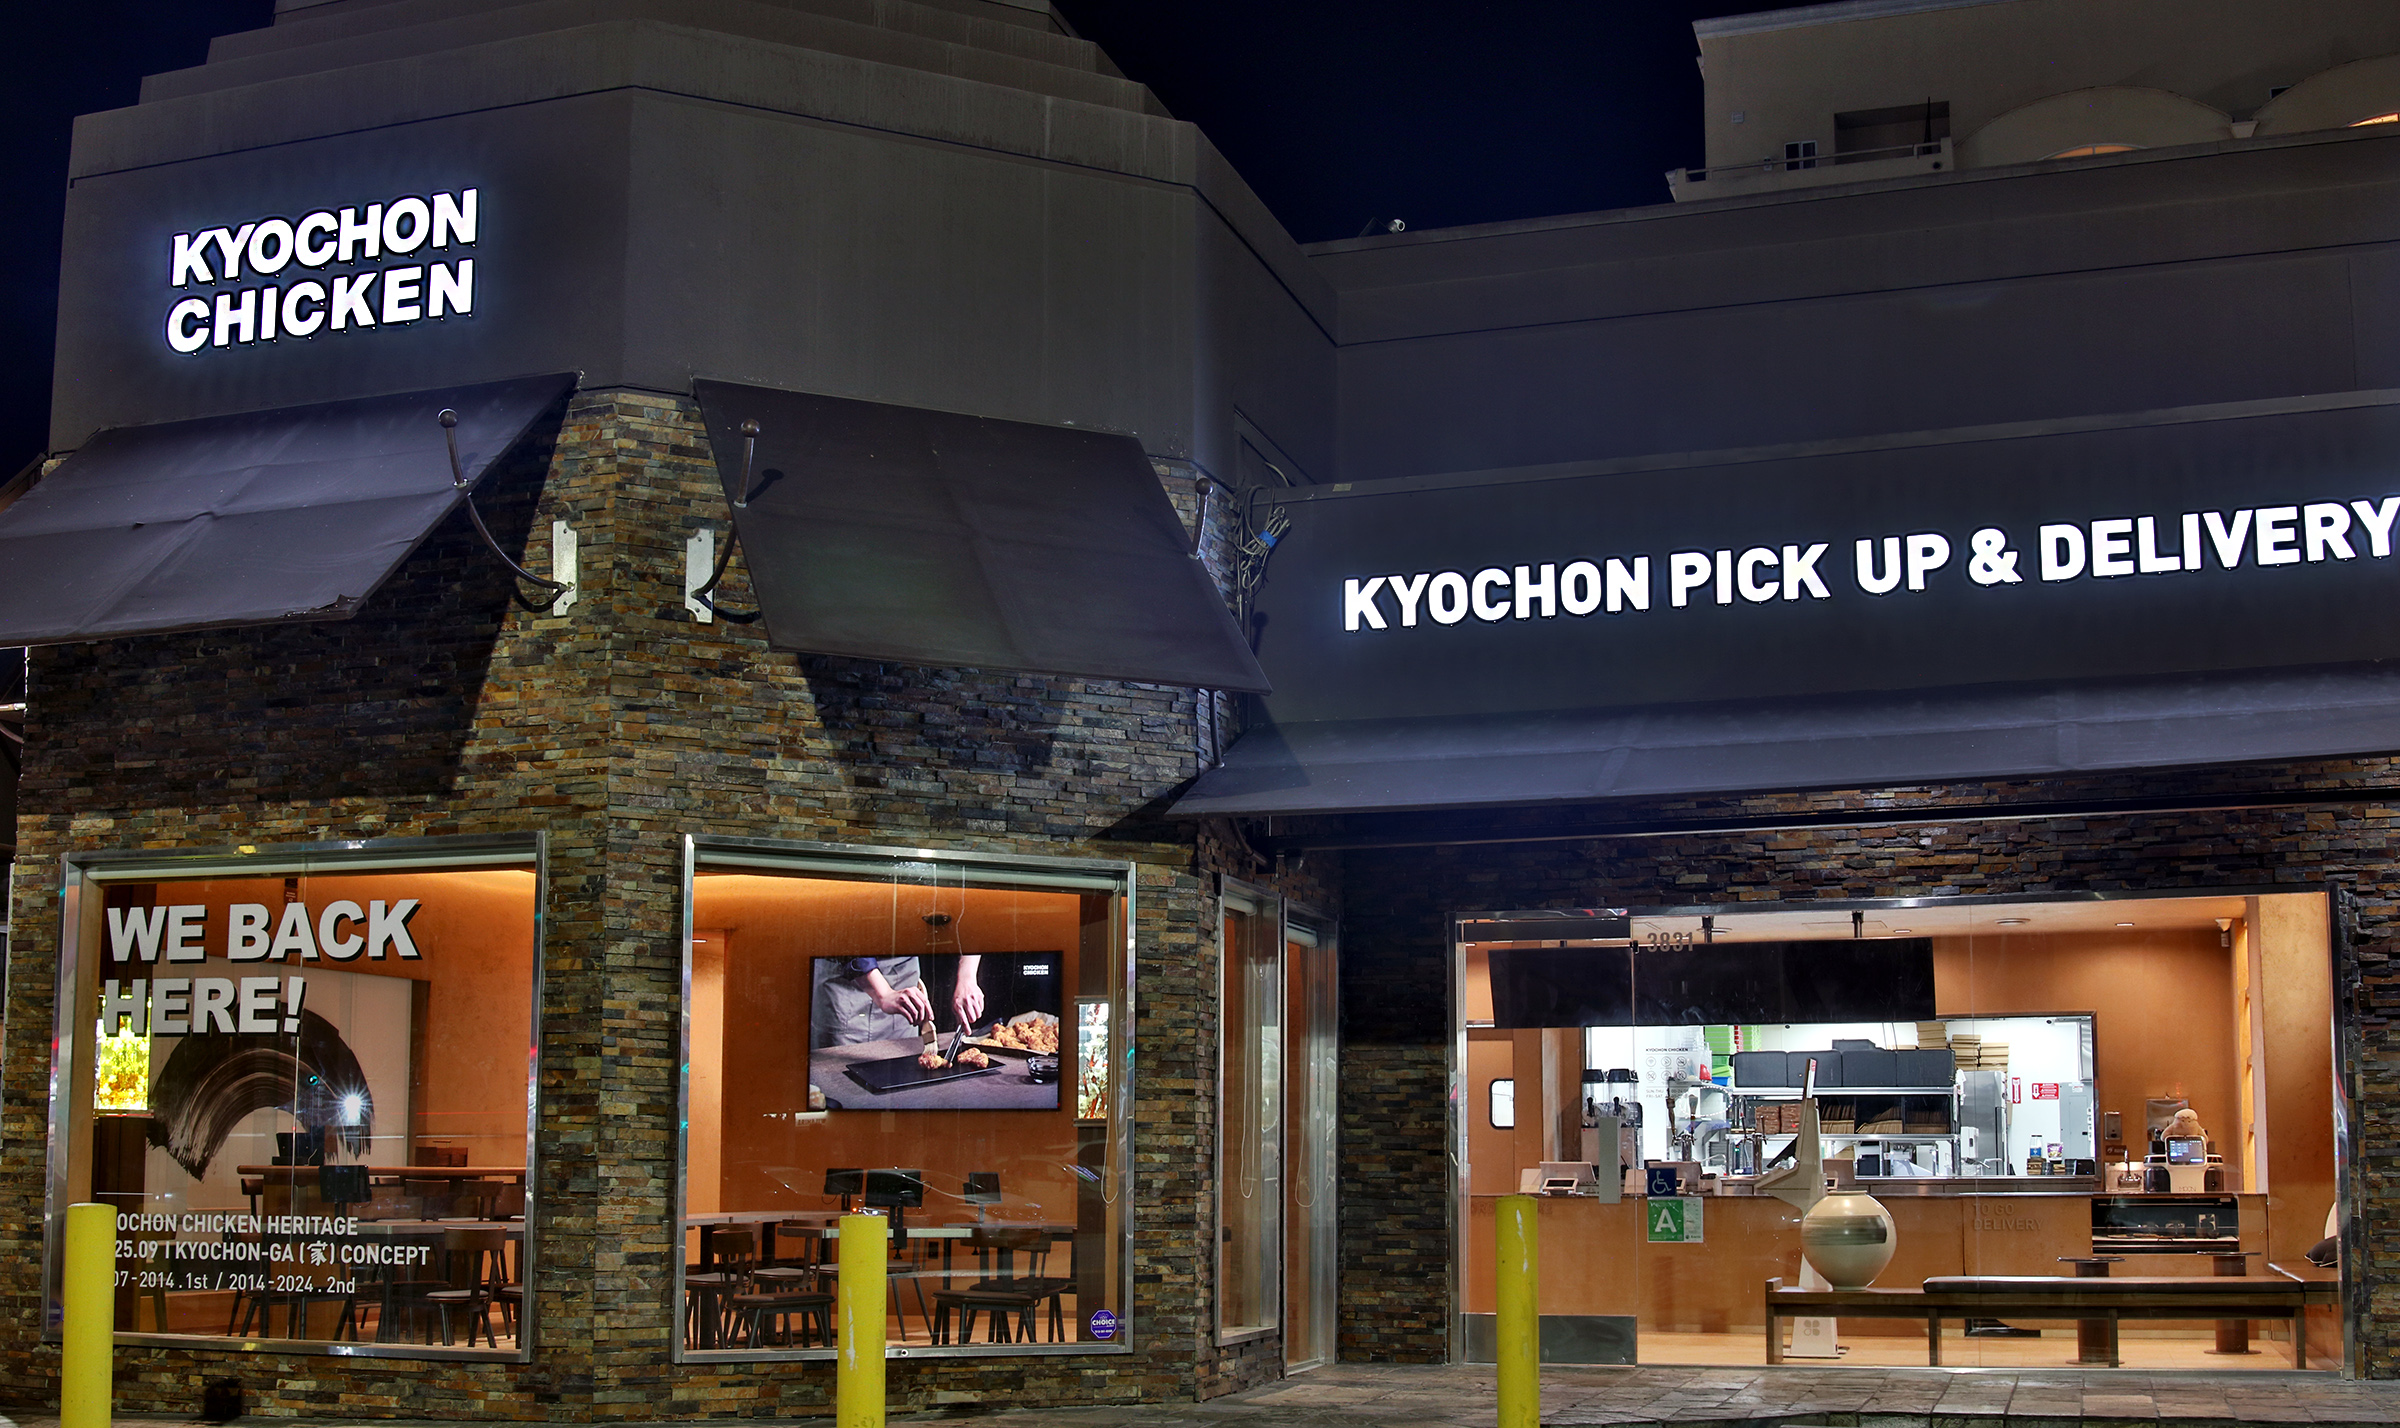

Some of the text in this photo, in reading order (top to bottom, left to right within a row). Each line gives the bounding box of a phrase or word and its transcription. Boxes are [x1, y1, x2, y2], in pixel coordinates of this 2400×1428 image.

[172, 188, 477, 286] KYOCHON
[167, 259, 473, 353] CHICKEN
[1344, 497, 2400, 631] KYOCHON PICK UP & DELIVERY
[107, 899, 420, 963] WE BACK
[1647, 931, 1693, 952] 3831
[104, 976, 304, 1034] HERE!
[1655, 1207, 1677, 1232] A
[1995, 1203, 2015, 1215] GO
[182, 1214, 262, 1233] CHICKEN
[267, 1215, 359, 1236] HERITAGE
[1974, 1218, 2043, 1230] DELIVERY
[175, 1241, 294, 1262] KYOCHON-GA
[341, 1244, 430, 1266] CONCEPT
